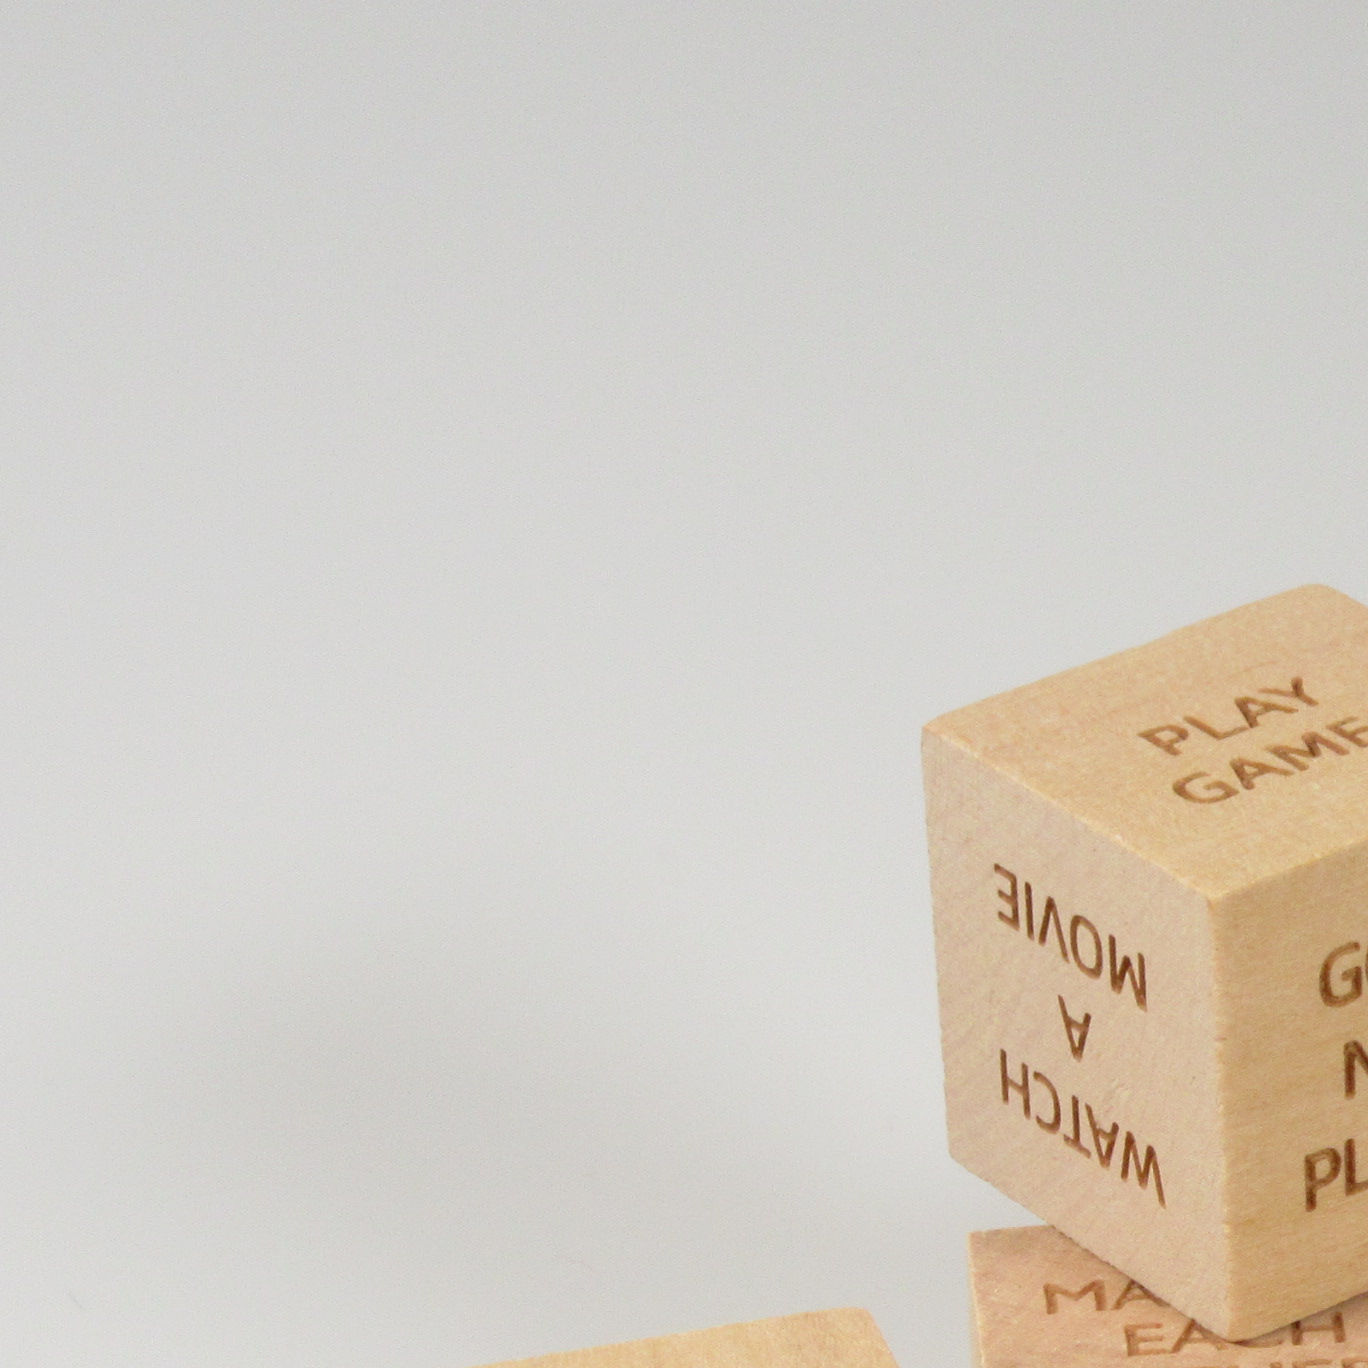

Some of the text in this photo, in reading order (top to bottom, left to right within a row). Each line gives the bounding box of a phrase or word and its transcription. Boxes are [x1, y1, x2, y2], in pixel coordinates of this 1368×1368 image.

[1138, 676, 1319, 755] PLAY
[993, 863, 1148, 1012] MOVIE
[1057, 994, 1092, 1062] A
[1000, 1048, 1166, 1208] WATCH
[1124, 1311, 1345, 1356] EAH
